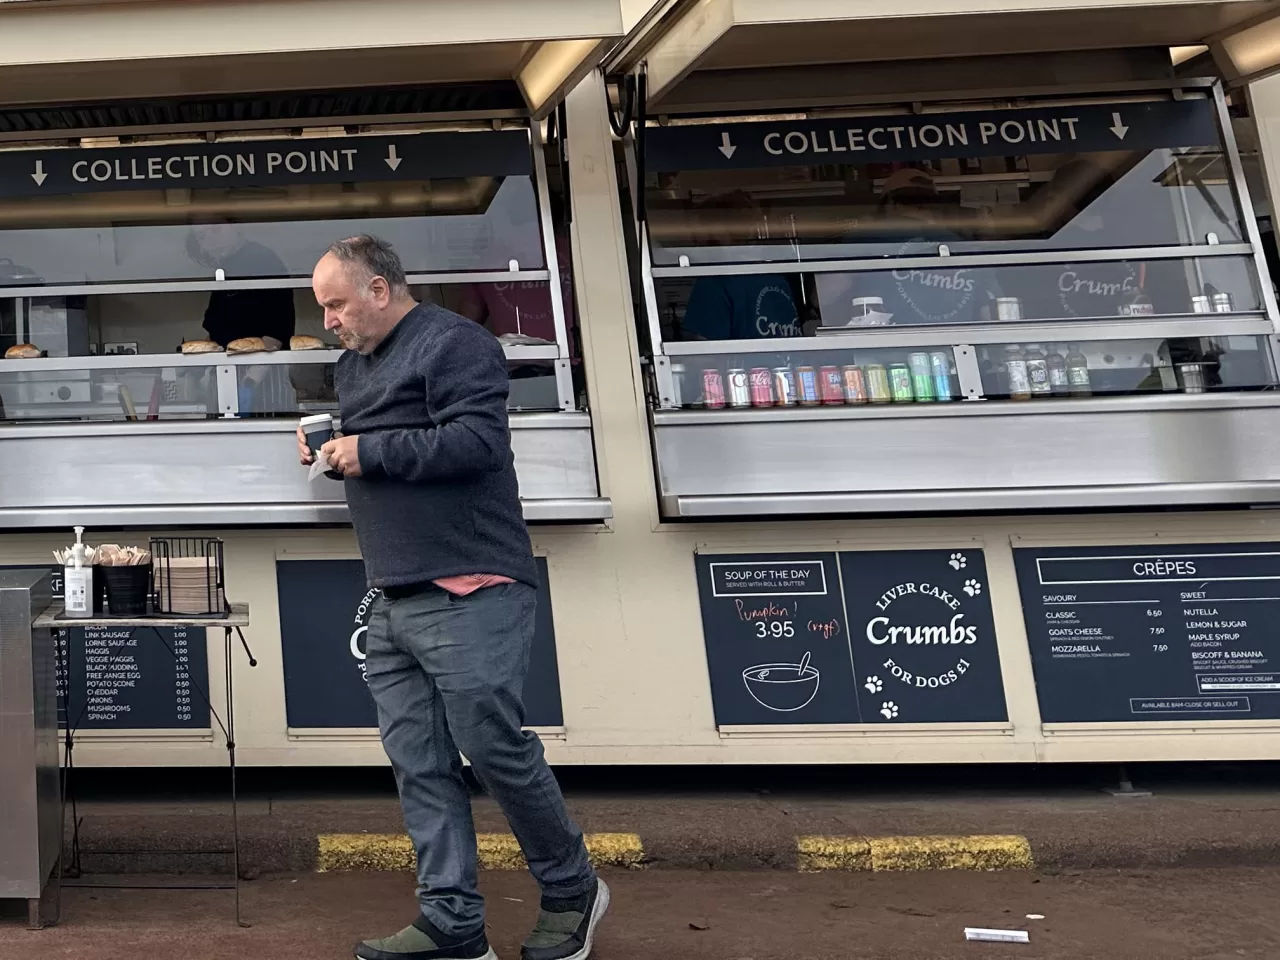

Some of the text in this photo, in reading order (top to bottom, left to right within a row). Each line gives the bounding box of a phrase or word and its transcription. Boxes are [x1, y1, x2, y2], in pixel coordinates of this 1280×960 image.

[763, 117, 1079, 155] COLLECTION POINT
[72, 148, 358, 183] COLLECTION POINT
[1133, 559, 1197, 576] CRÊPES
[725, 570, 810, 580] SOUP OF THE DAY
[876, 582, 961, 611] LIVER CAKE
[1183, 608, 1218, 616] NUTELLA
[755, 621, 795, 637] 3.95
[866, 613, 977, 645] Crumbs
[1048, 628, 1073, 636] GOATS
[1150, 627, 1165, 635] 7.50
[1186, 621, 1213, 629] LEMON
[1188, 633, 1240, 641] MAPLE SYRUP
[1052, 644, 1168, 653] MOZZARELLA 7.50
[1192, 651, 1223, 659] BISCOFF
[883, 658, 971, 688] FOR DOGS £1
